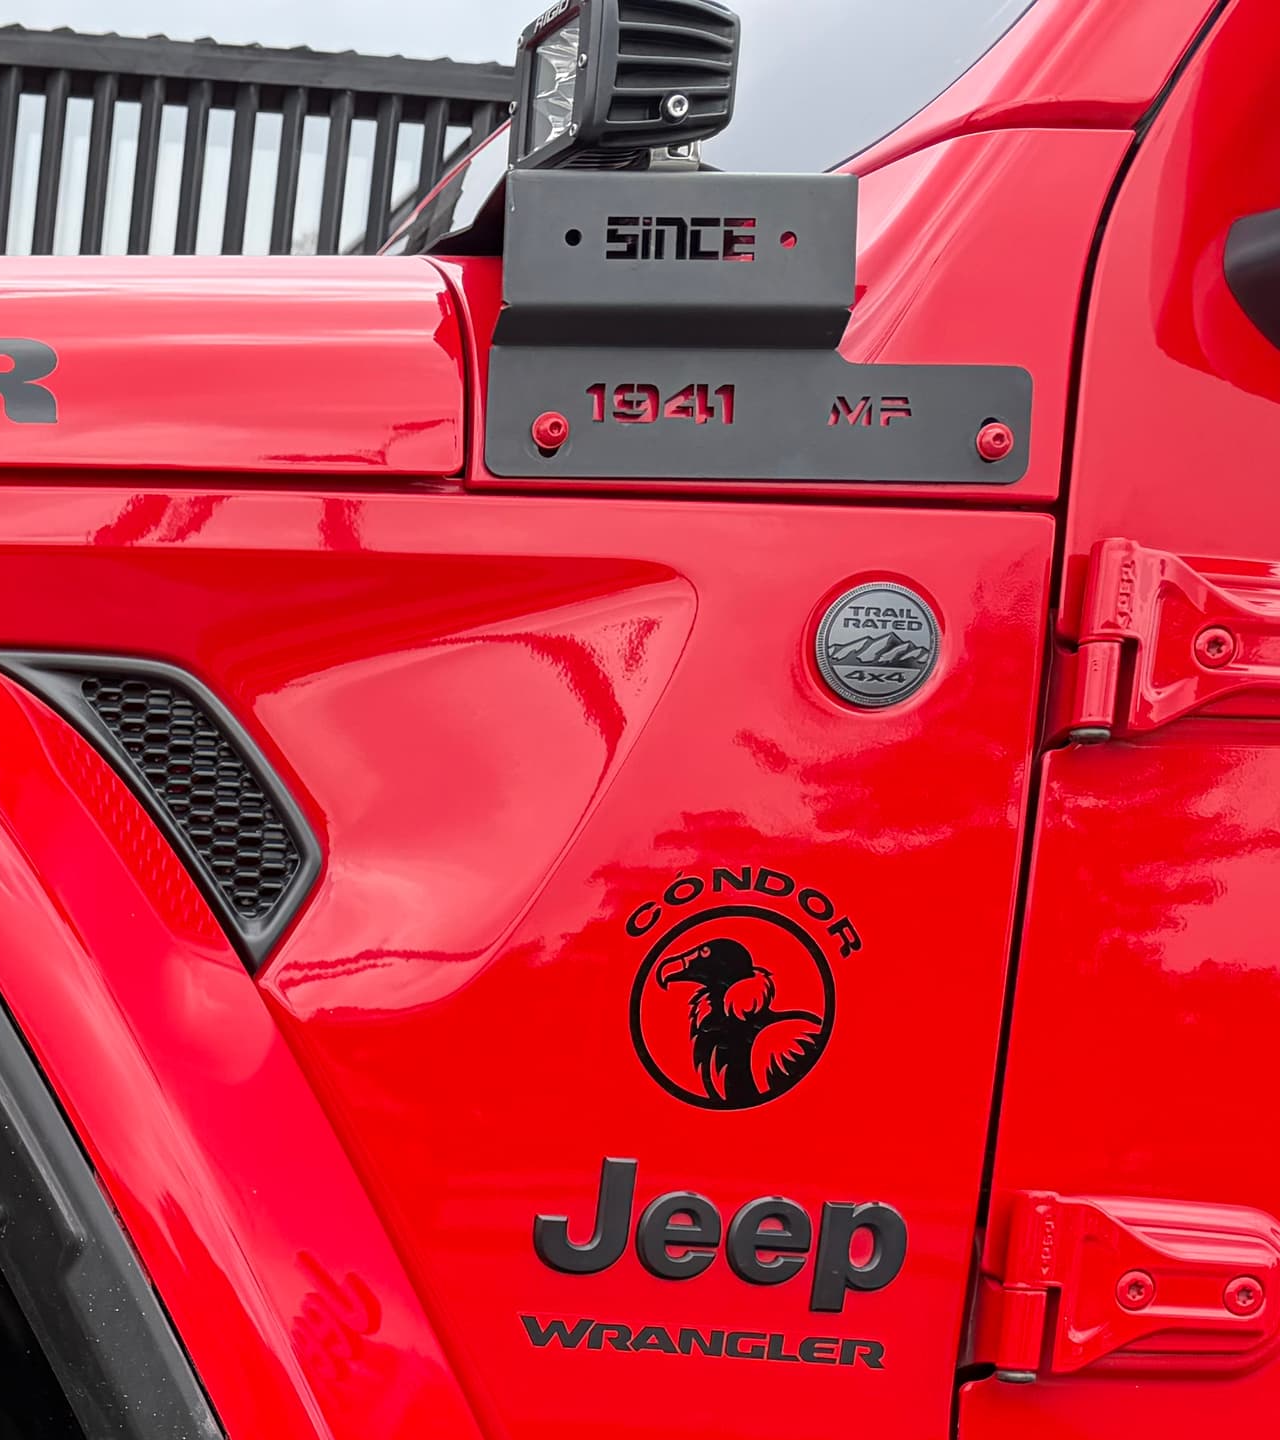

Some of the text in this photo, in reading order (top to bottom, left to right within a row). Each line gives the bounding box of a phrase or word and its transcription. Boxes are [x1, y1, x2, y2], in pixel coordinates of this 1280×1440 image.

[586, 383, 735, 425] 1941
[843, 618, 923, 631] RATED
[848, 606, 919, 619] TRAIL
[625, 866, 863, 959] CÓNDOR
[533, 1156, 908, 1313] Jeep
[520, 1314, 886, 1369] WRANGLER
